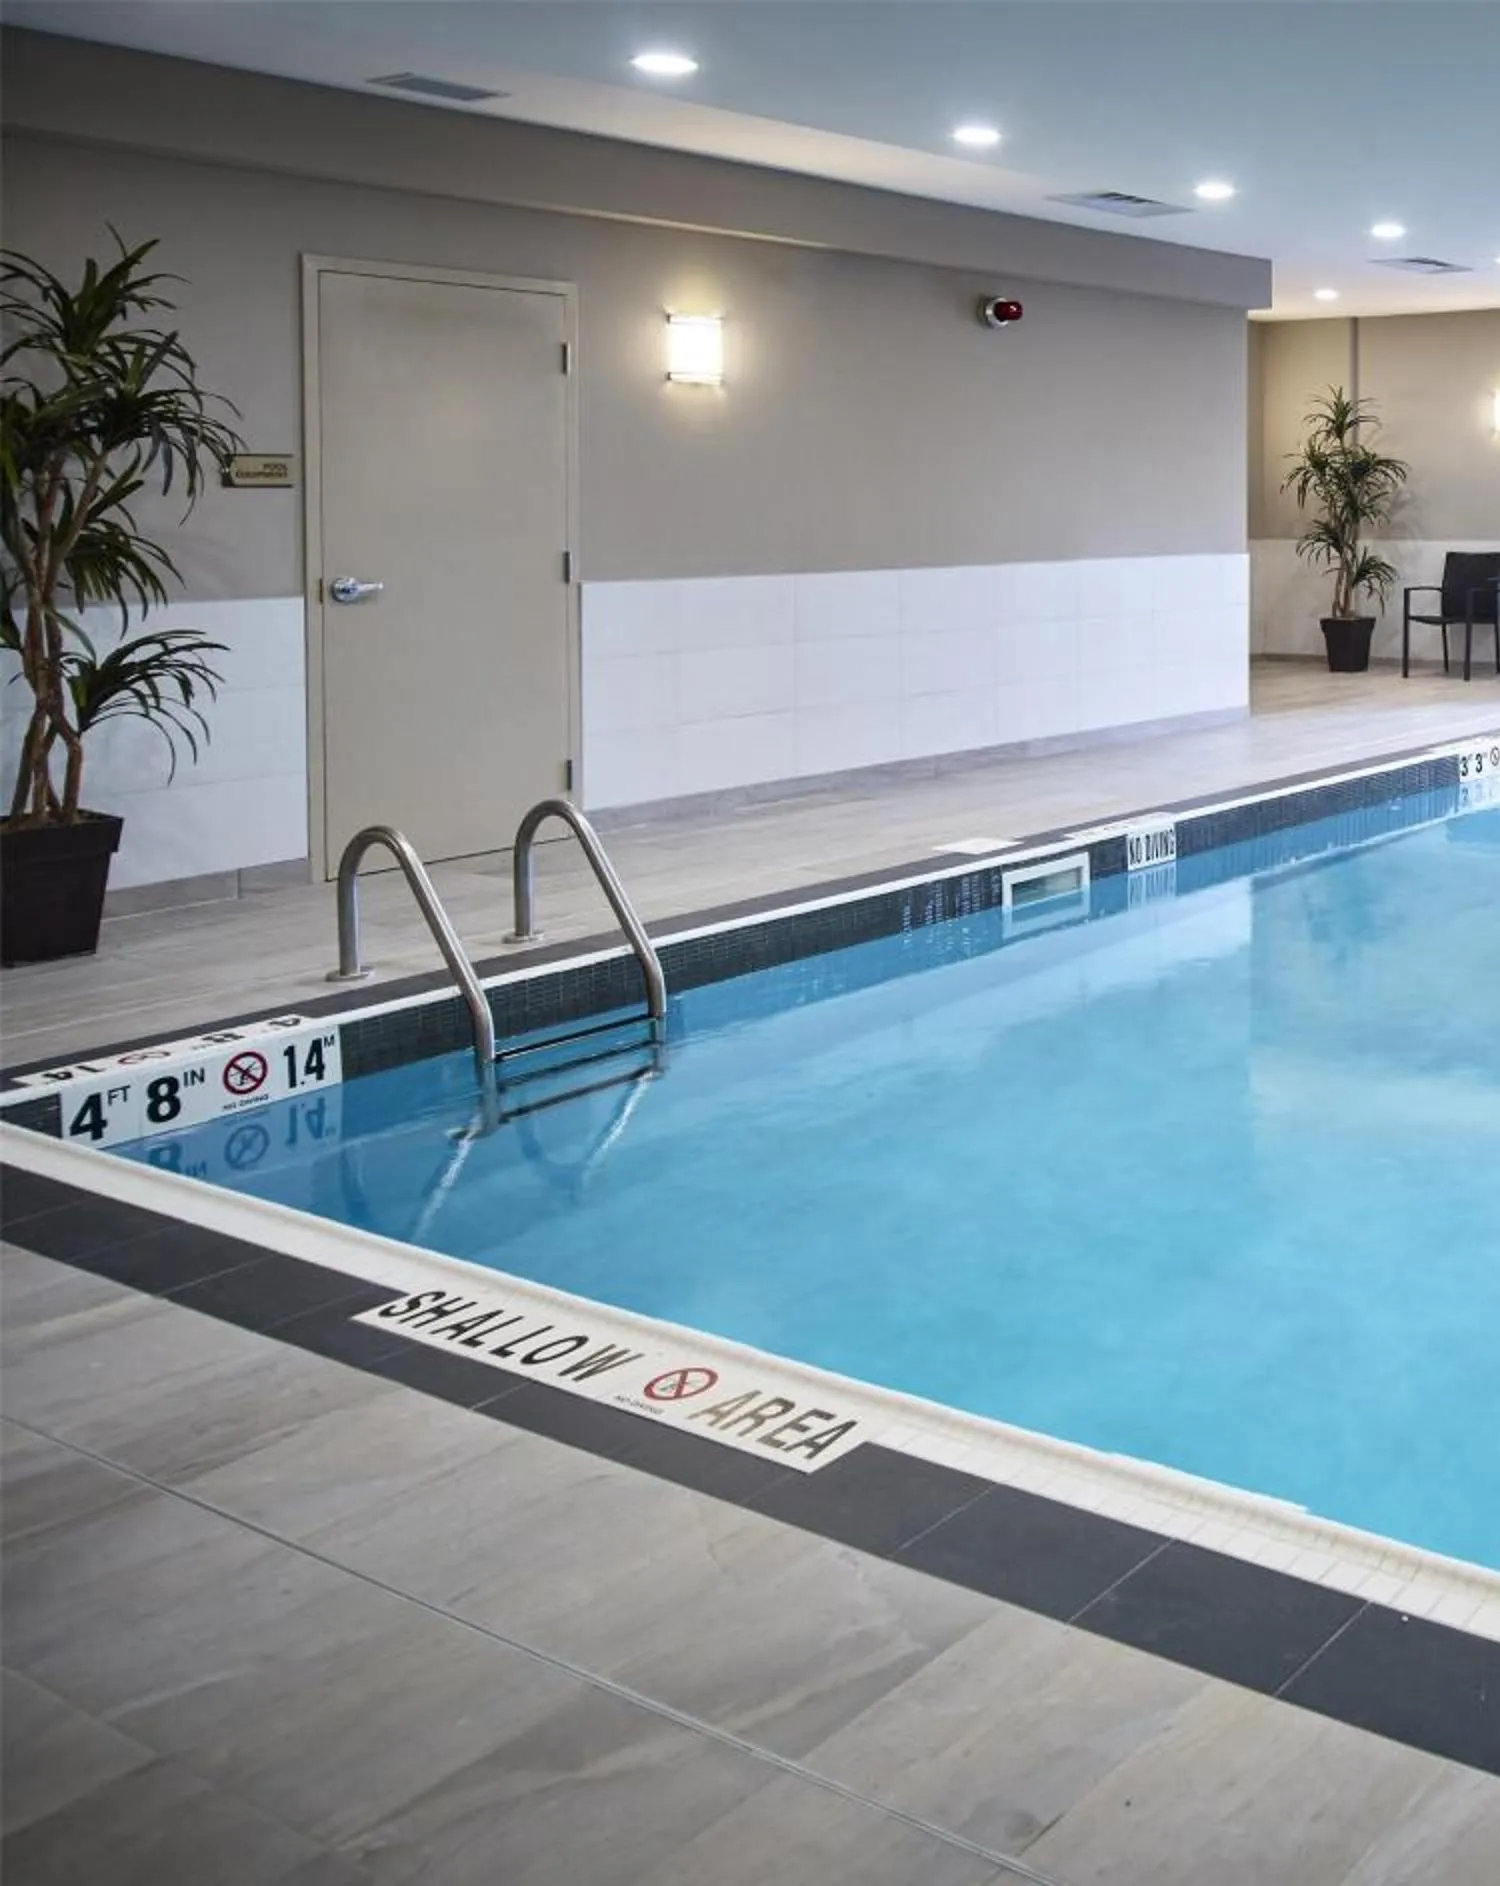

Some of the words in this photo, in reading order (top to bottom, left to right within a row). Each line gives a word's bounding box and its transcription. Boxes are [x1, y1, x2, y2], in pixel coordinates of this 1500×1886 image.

[1461, 756, 1469, 777] 3
[1475, 753, 1483, 773] 3
[1129, 837, 1142, 865] NO
[69, 1092, 108, 1141] 4
[107, 1085, 131, 1106] FT
[146, 1075, 182, 1123] 8
[183, 1067, 206, 1088] IN
[283, 1037, 326, 1089] 1.4
[377, 1290, 645, 1383] SHALLOW
[689, 1389, 859, 1461] AREA
